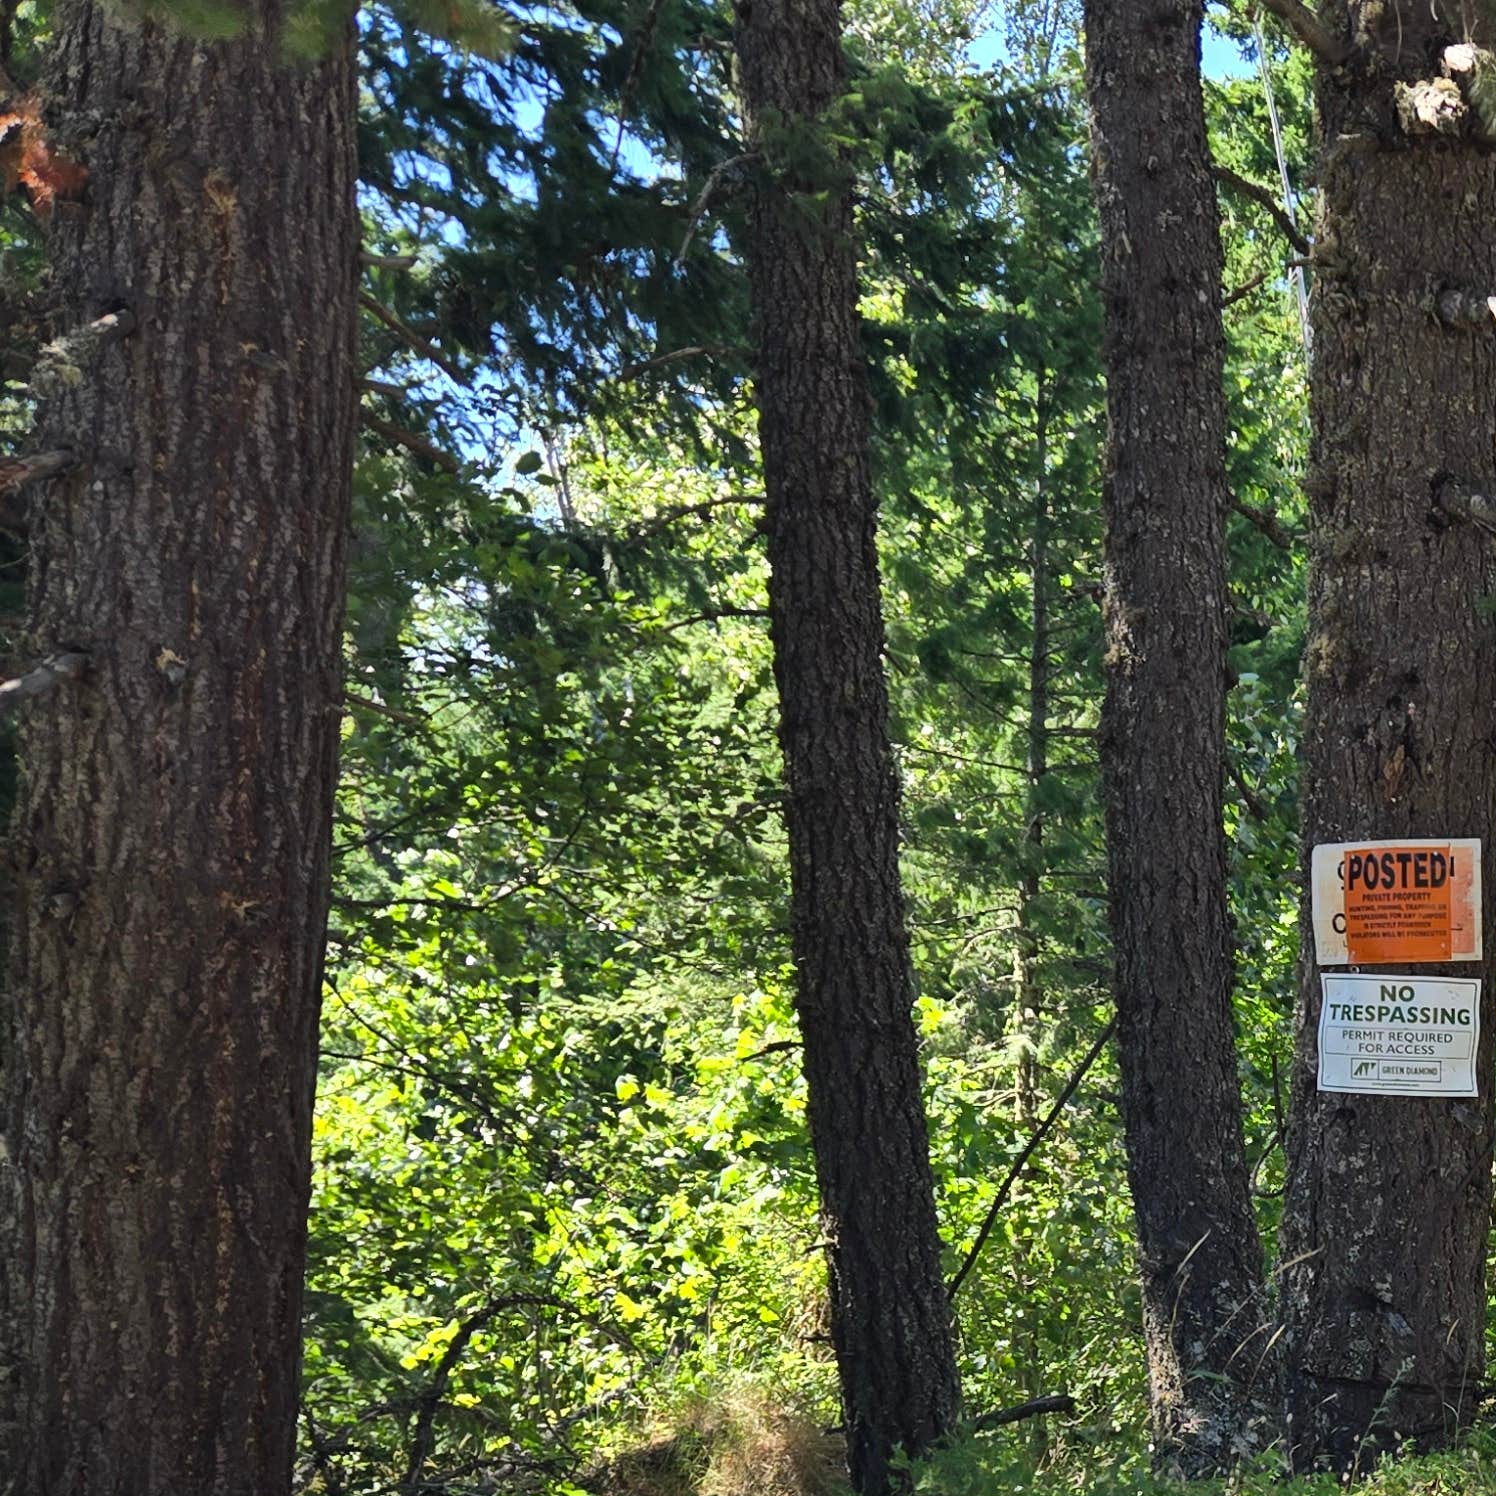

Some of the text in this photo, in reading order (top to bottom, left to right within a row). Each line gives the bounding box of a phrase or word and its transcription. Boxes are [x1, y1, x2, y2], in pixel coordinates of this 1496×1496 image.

[1348, 852, 1447, 891] POSTED
[1362, 892, 1431, 902] PRIVATE PROPERTY
[1380, 985, 1415, 1002] NO
[1330, 1004, 1470, 1026] TRESPASSING
[1342, 1031, 1453, 1043] PERMIT REQUIRED
[1358, 1043, 1435, 1055] FOR ACCESS
[1382, 1066, 1437, 1076] GREEN DIAMOND
